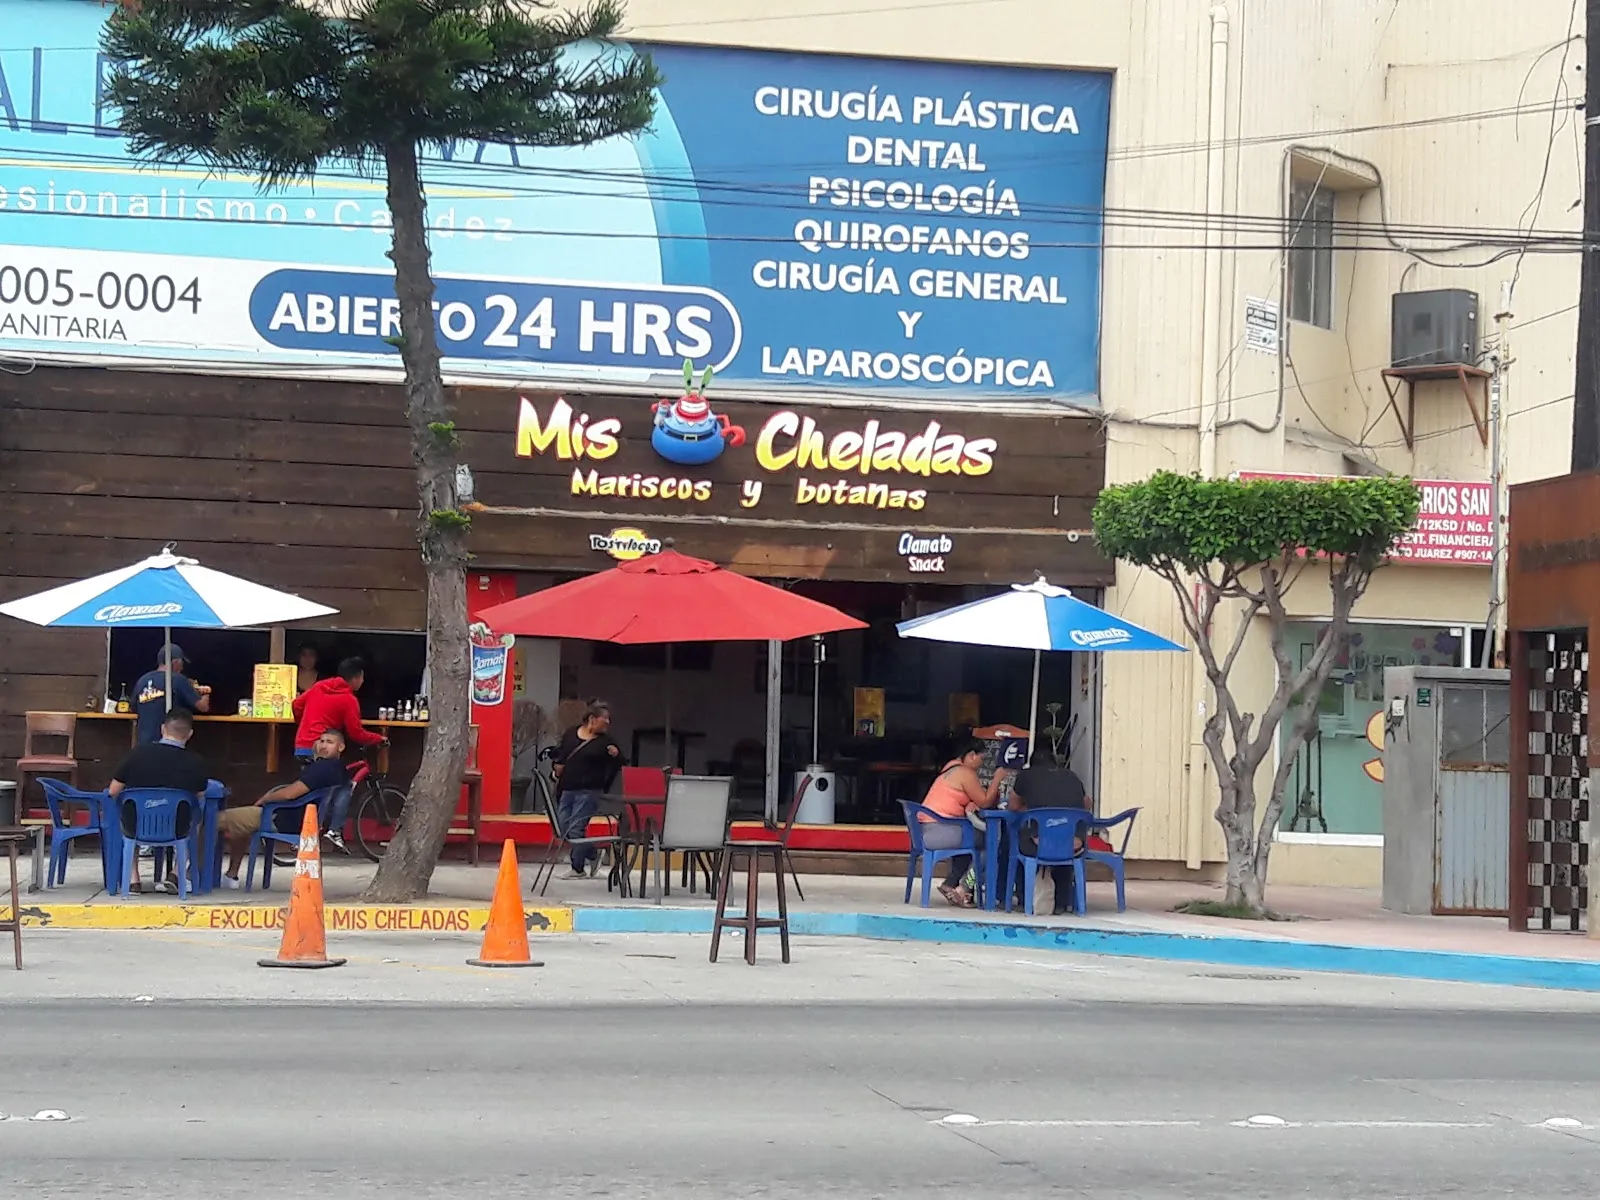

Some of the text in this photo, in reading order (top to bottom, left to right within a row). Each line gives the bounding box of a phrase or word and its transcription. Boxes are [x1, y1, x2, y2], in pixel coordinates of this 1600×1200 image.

[754, 85, 1080, 134] CIRUGÍA PLÁSTICA
[847, 135, 986, 172] DENTAL
[808, 176, 1021, 217] PSICOLOGÍA
[334, 200, 514, 241] Cadez
[794, 219, 1030, 260] QUIROFANOS
[0, 265, 203, 315] 005-0004
[753, 258, 1068, 304] CIRUGÍA GENERAL
[0, 312, 128, 341] ANITARIA
[483, 294, 556, 351] 24
[578, 300, 713, 359] HRS
[898, 311, 923, 338] Y
[761, 346, 1055, 388] LAPAROSCÓPICA
[515, 396, 998, 477] Mis Cheladas
[570, 467, 928, 511] Mariscos y botanas
[1418, 486, 1490, 516] RIOS SAN
[898, 532, 953, 555] Clamato
[908, 555, 946, 572] Snack
[1415, 548, 1453, 559] JUAREZ
[332, 908, 368, 930] MIS
[374, 909, 471, 931] CHELADAS
